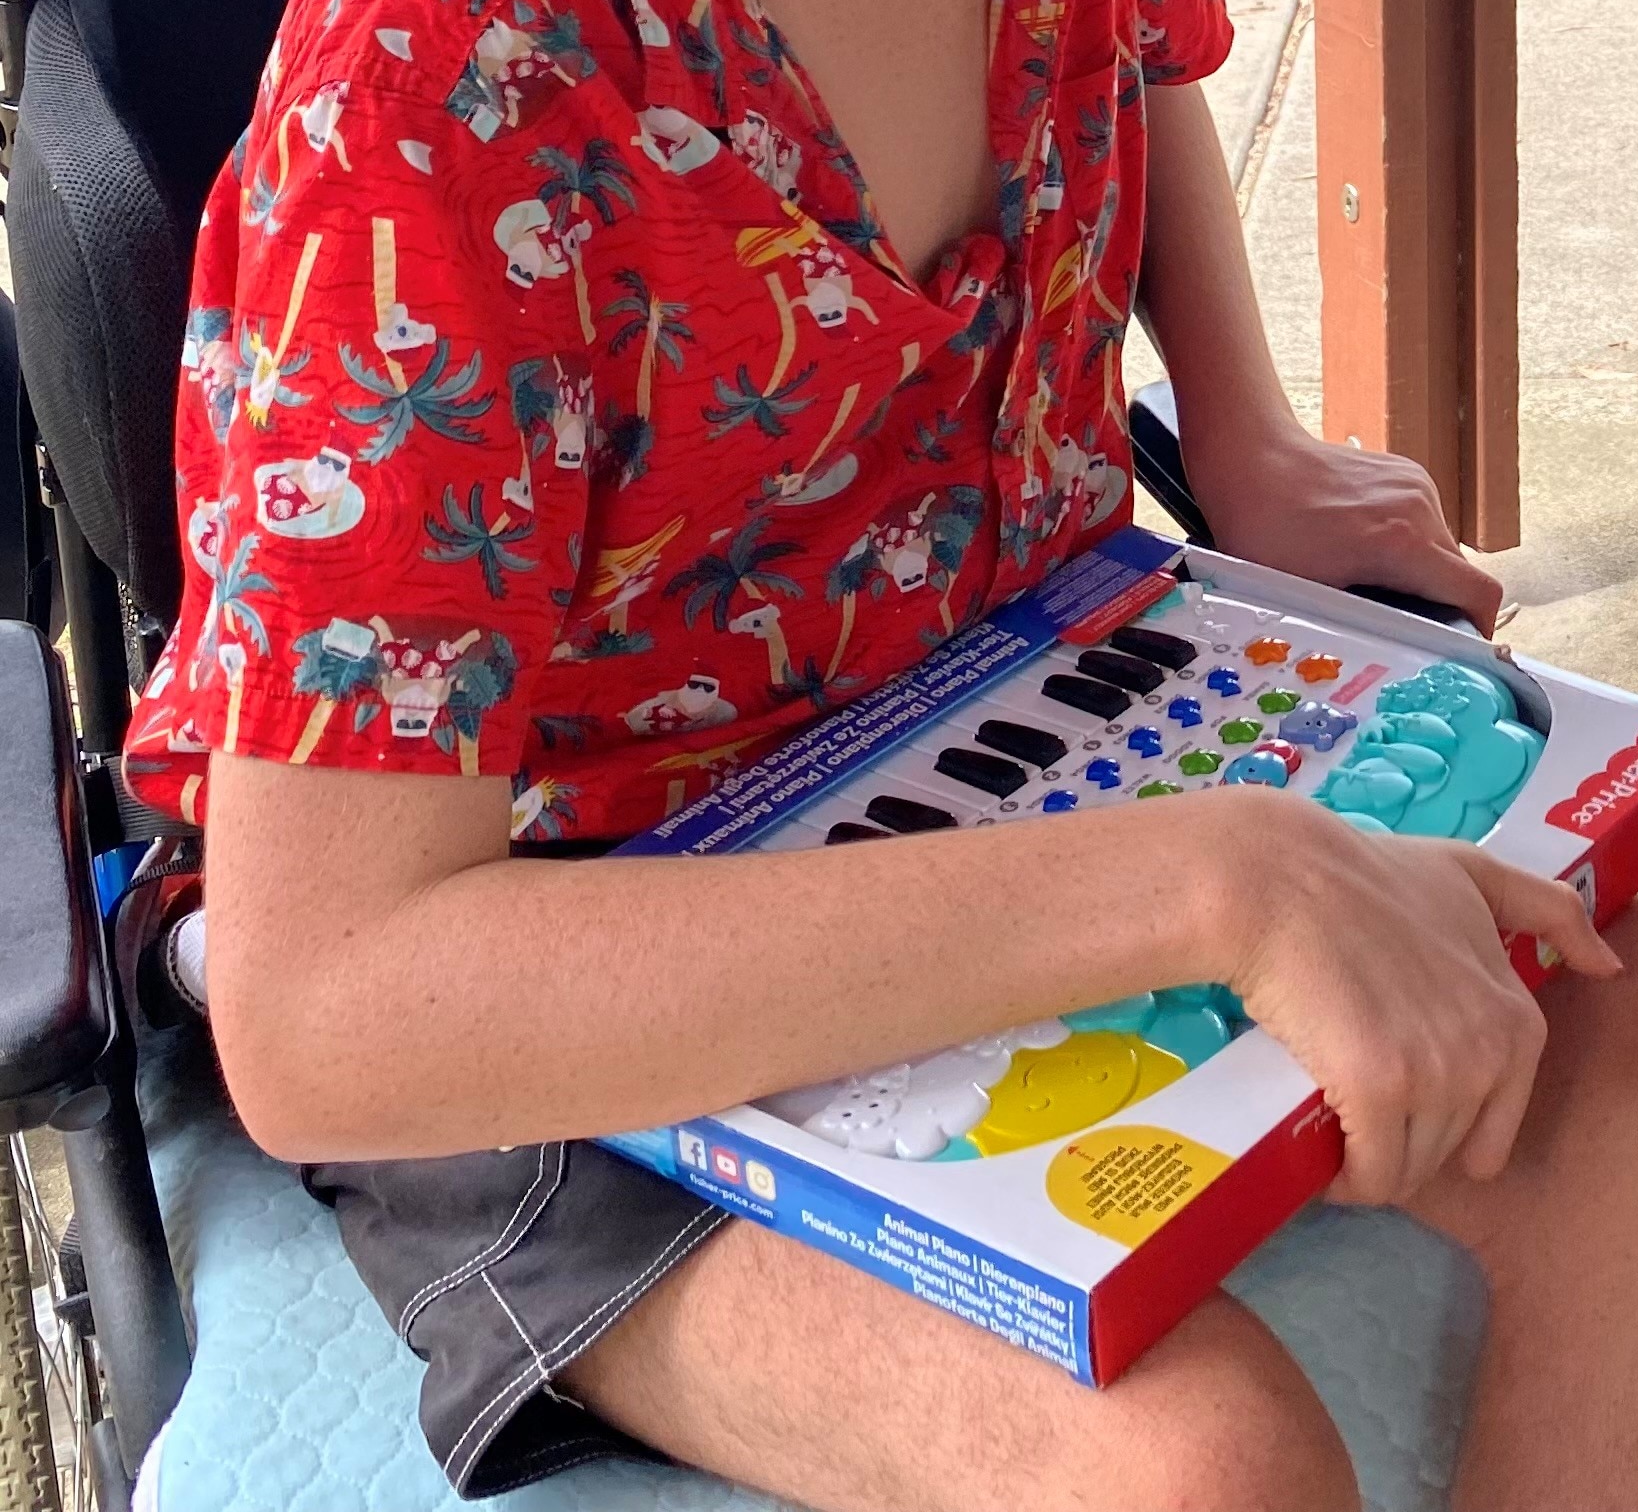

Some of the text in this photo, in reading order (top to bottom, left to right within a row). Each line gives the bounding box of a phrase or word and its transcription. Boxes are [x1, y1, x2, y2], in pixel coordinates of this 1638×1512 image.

[924, 630, 1014, 685] Tier-Klavier
[833, 726, 861, 742] Ze
[856, 689, 919, 726] Pianino
[692, 637, 1030, 853] Animal Piano Dierenpiano Piano Animaux
[764, 710, 856, 766] Pianoforte
[719, 766, 769, 796] Degli
[653, 793, 722, 838] Animali
[689, 1172, 774, 1220] fisher-price.com
[801, 1210, 848, 1243] Pianino
[849, 1231, 866, 1252] Ze
[995, 1302, 1013, 1324] Se
[876, 1227, 1066, 1333] Piano Animaux Tier-Klavier
[884, 1213, 1066, 1314] Animal Piano Dierenpiano
[913, 1278, 1078, 1375] Pianoforte Degli Animali
